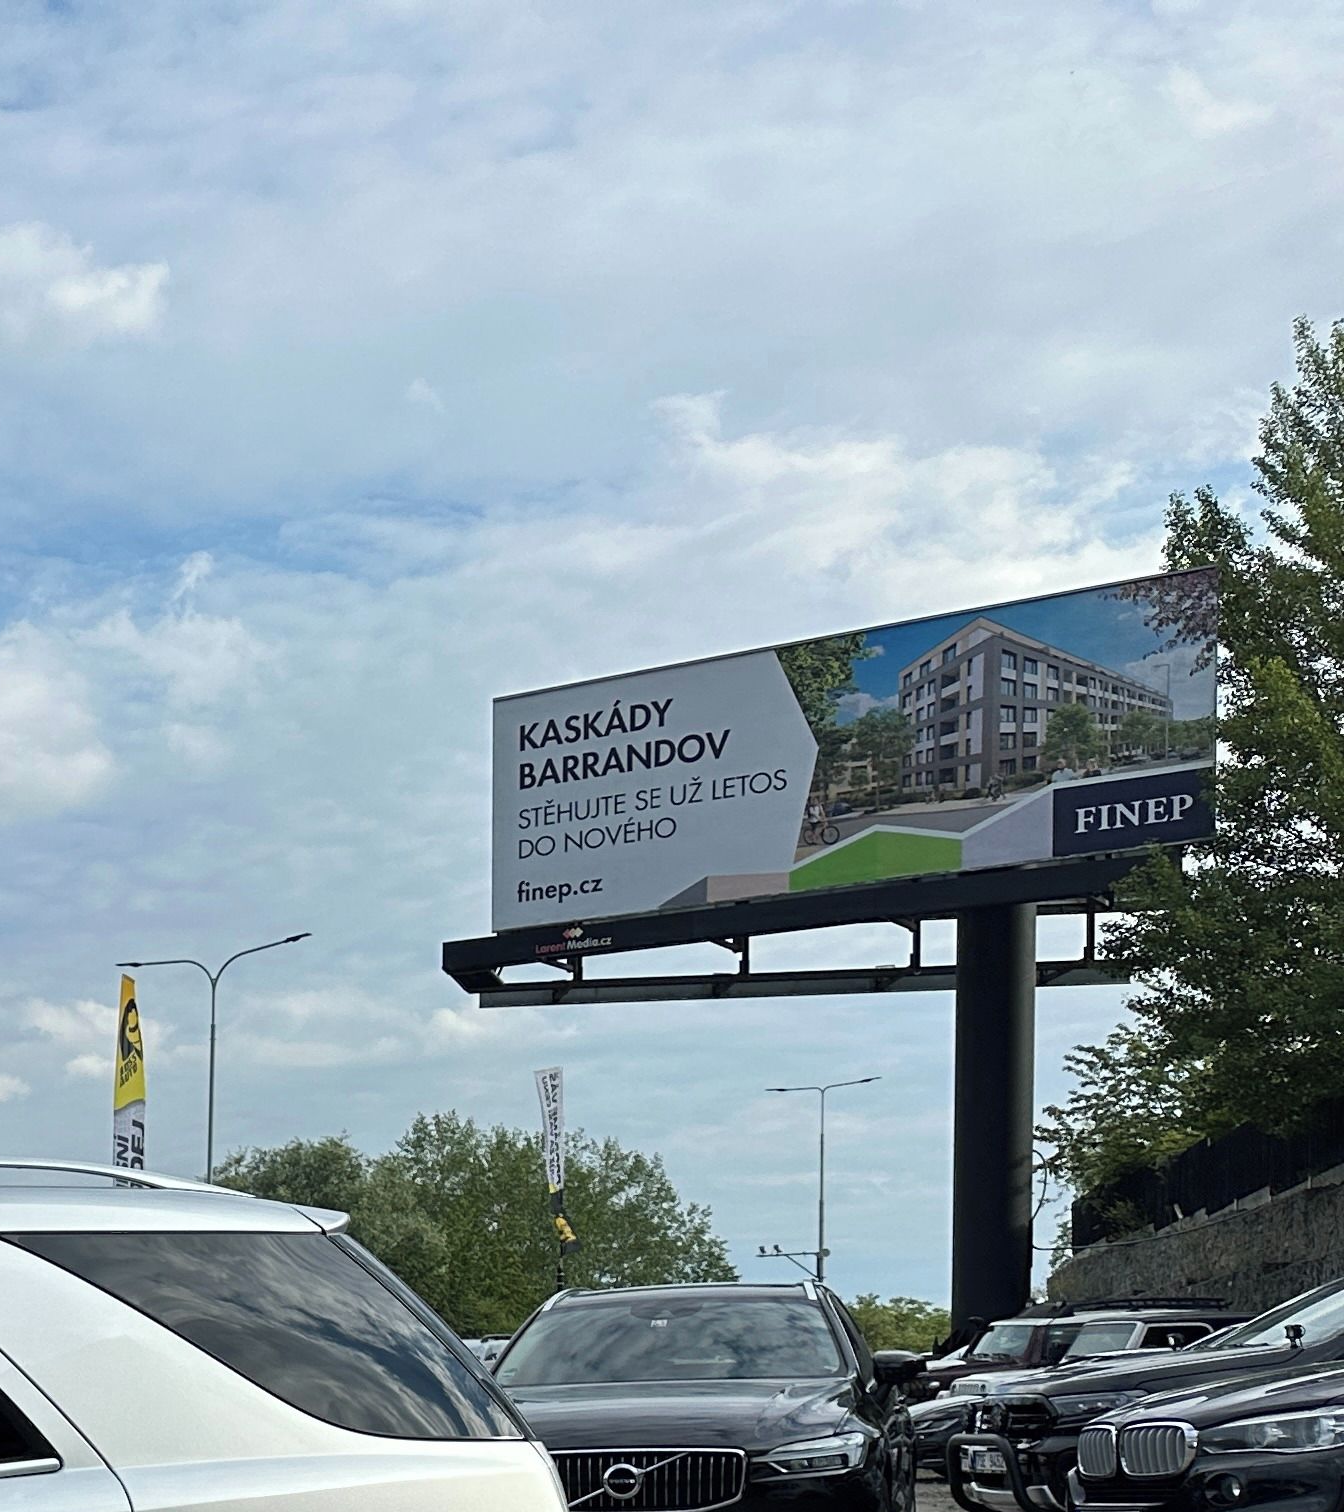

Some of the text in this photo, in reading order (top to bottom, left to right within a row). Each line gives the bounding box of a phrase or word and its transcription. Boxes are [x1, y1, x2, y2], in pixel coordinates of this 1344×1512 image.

[519, 698, 674, 752] KASKÁDY
[519, 729, 731, 790] BARRANDOV
[518, 769, 788, 830] STĚHUJTE SE UŽ LETOS
[1074, 794, 1194, 834] FINEP
[518, 817, 678, 860] DO NOVÉHO
[517, 878, 604, 903] finep.cz
